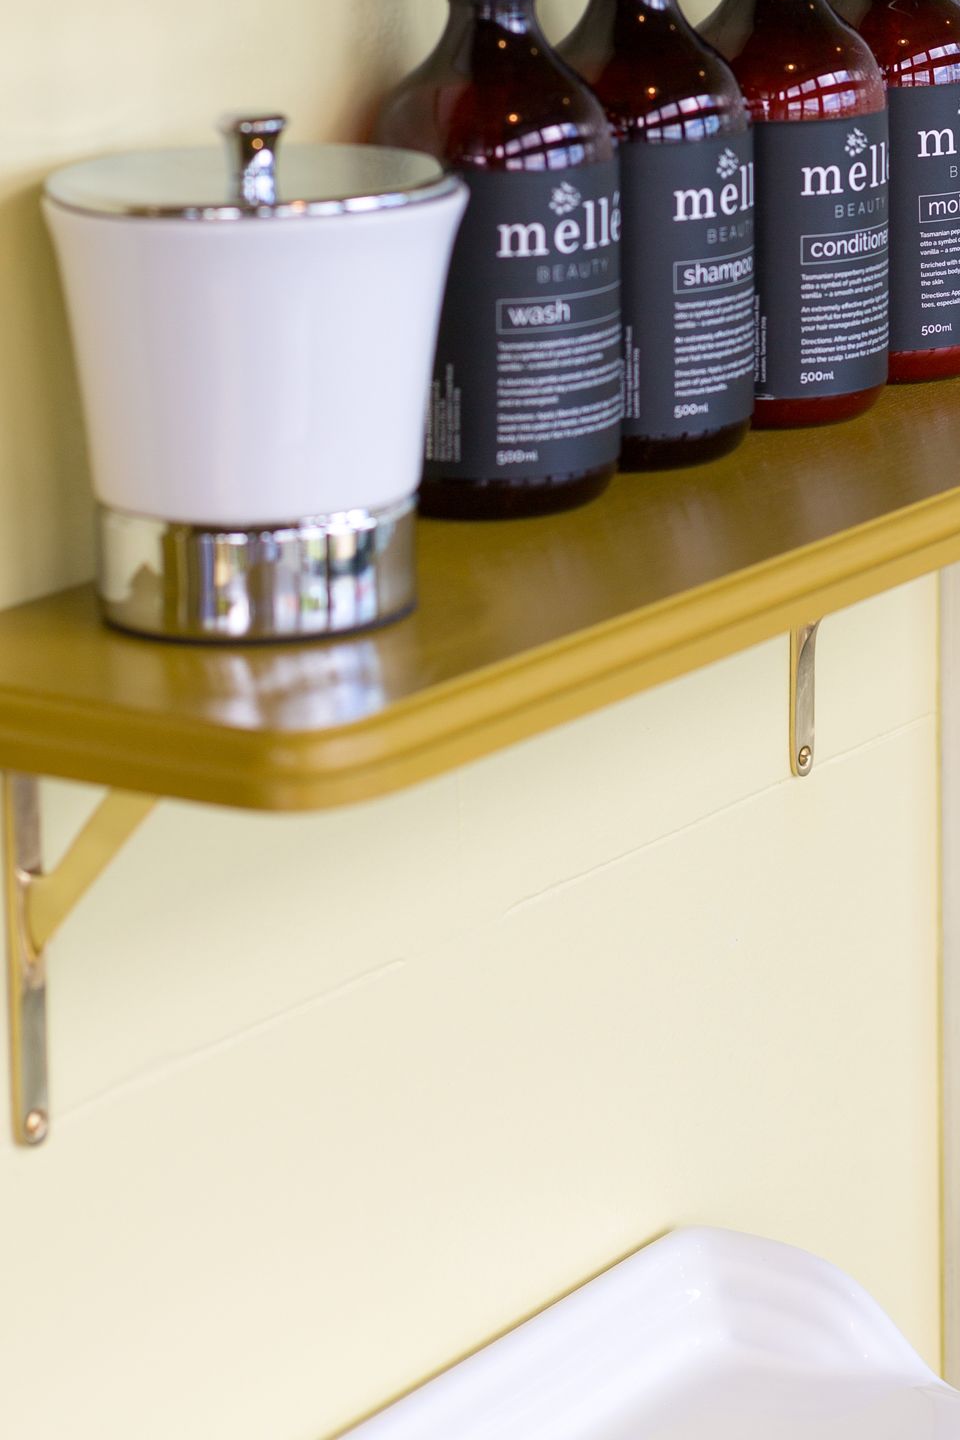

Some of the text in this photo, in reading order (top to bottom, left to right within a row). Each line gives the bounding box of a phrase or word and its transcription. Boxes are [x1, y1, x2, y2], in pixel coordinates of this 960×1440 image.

[920, 230, 950, 238] Tasmanian
[938, 238, 957, 246] symbol
[536, 258, 608, 284] BEAUTY
[508, 298, 570, 326] wash
[922, 323, 952, 336] 500ml
[801, 371, 834, 384] 500ml
[674, 403, 708, 418] 500ml
